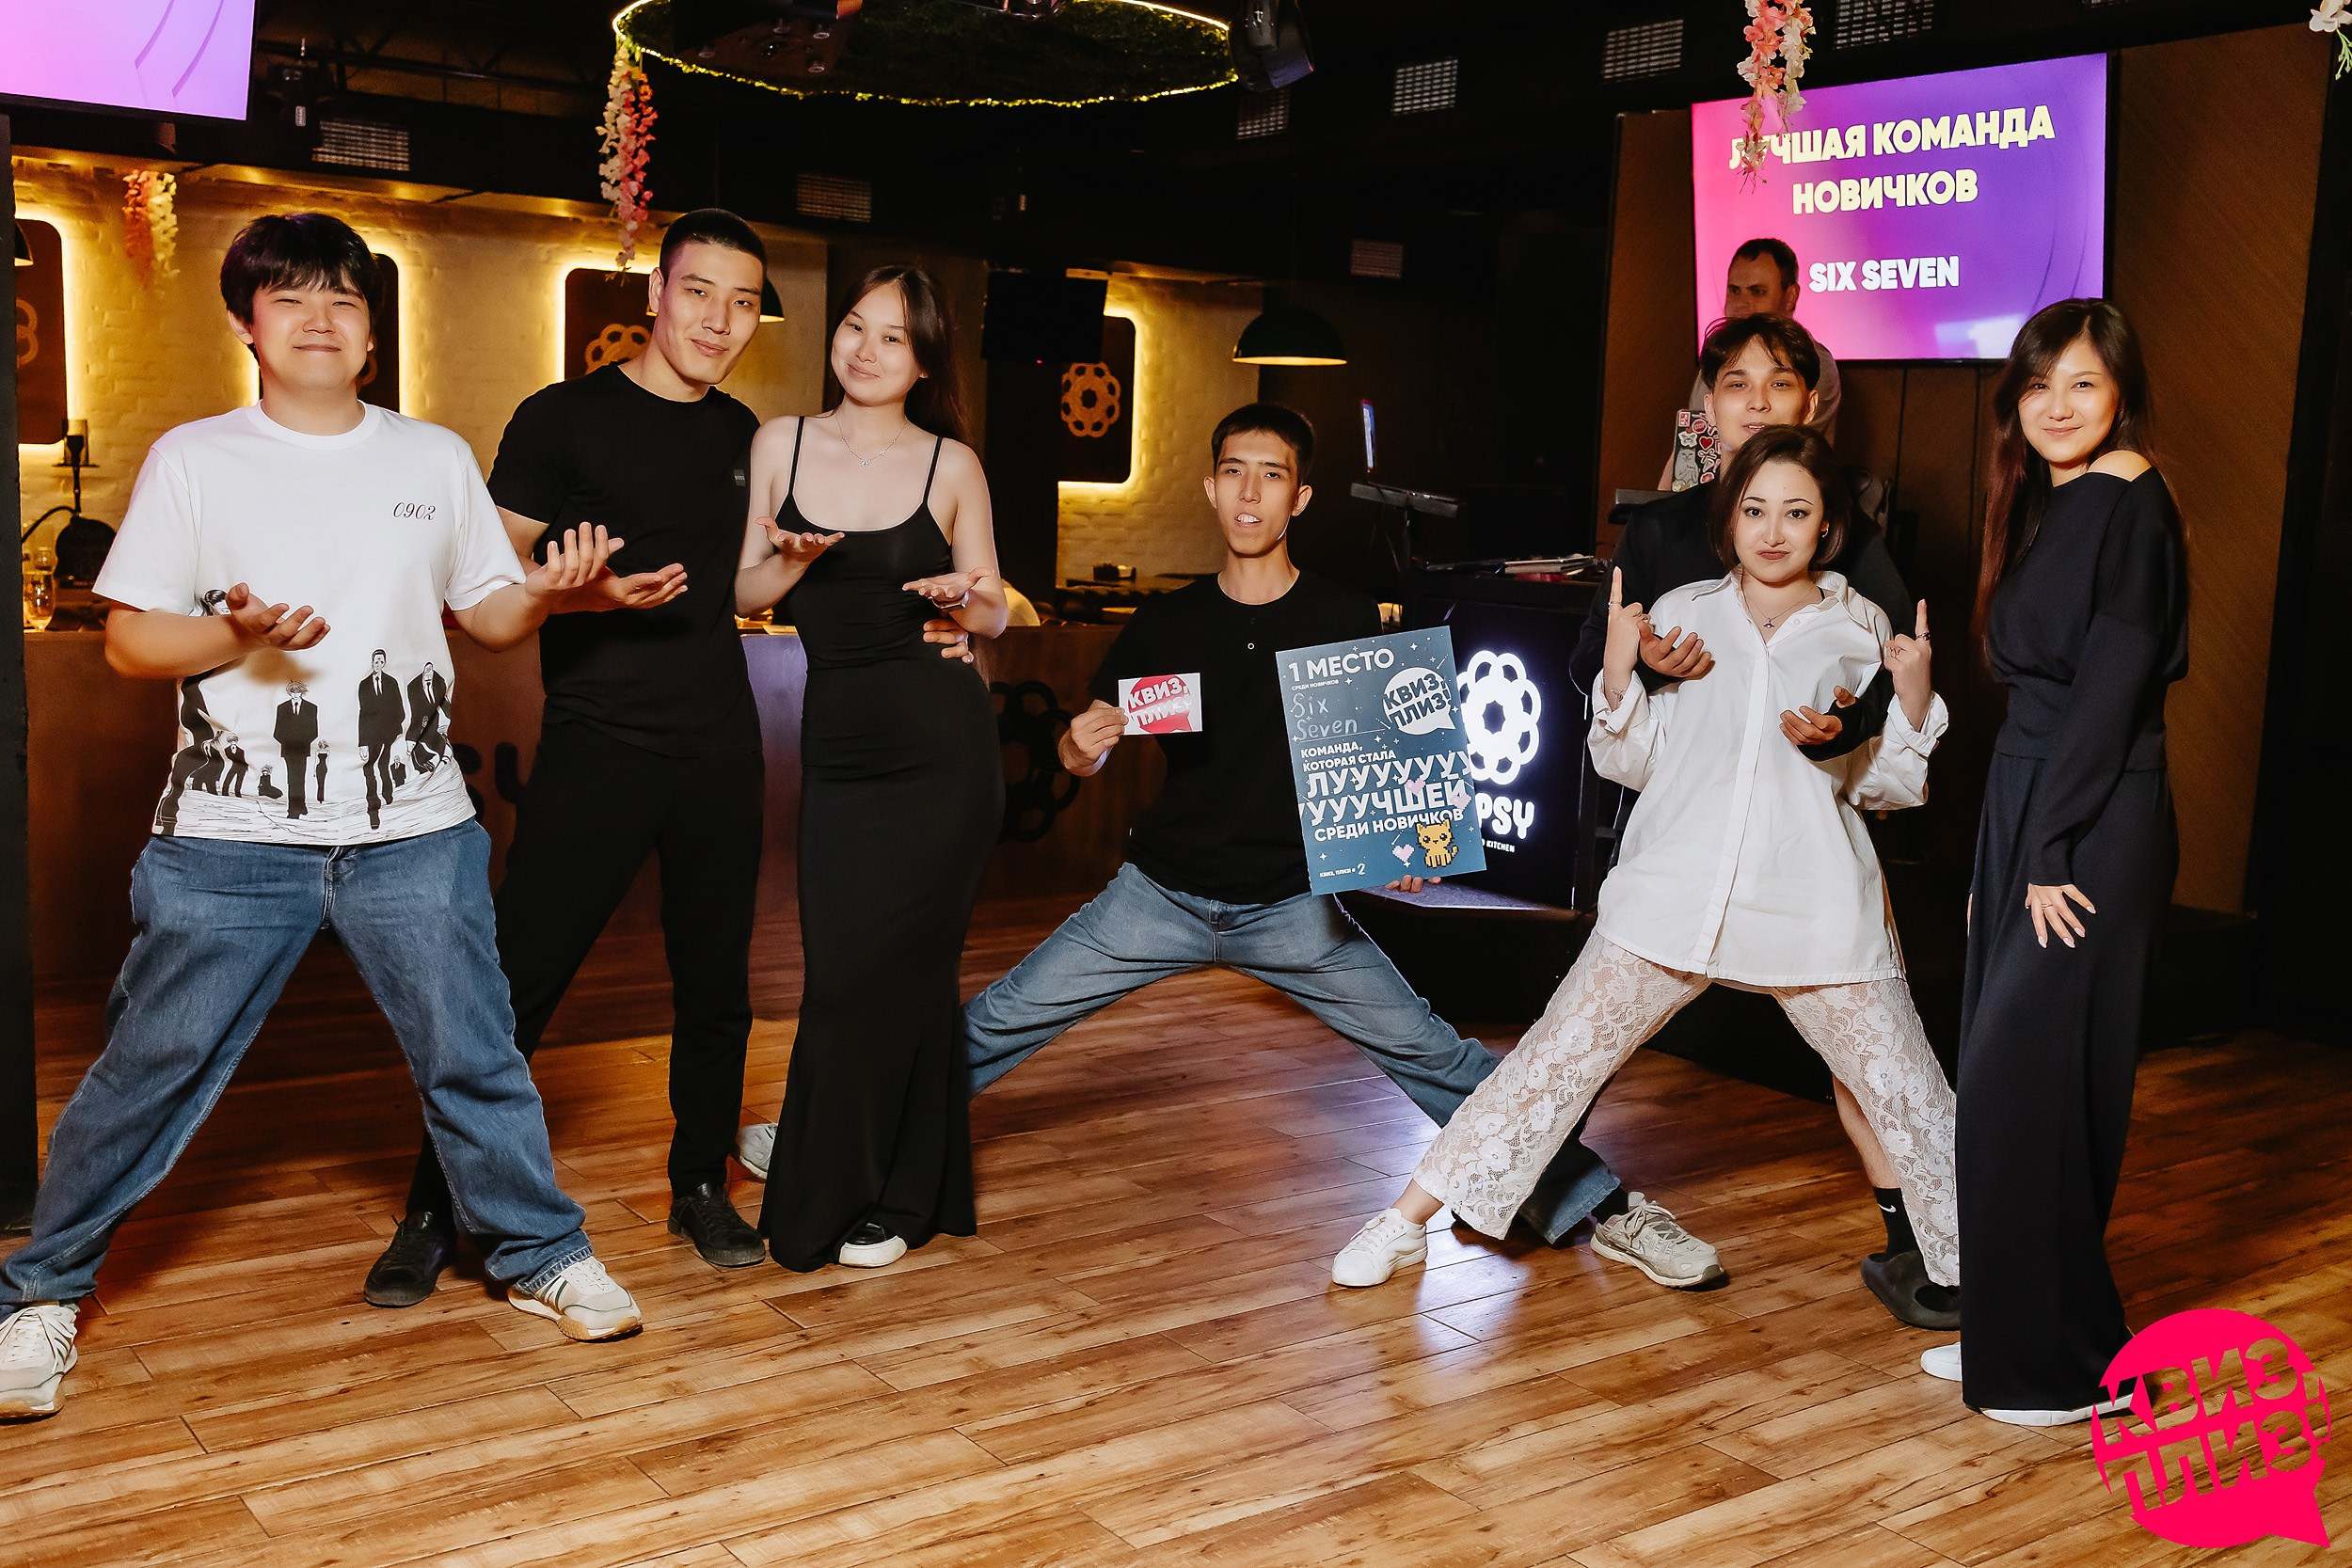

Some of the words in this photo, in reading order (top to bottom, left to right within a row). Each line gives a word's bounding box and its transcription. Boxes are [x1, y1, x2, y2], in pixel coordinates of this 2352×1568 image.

[1728, 124, 1867, 170] ЛЧШАЯ
[1873, 104, 2056, 156] КОМАНДА
[1792, 168, 1979, 214] НОВИЧКОВ
[1808, 260, 1857, 293] SIX
[1861, 255, 1960, 292] SEVEN
[393, 501, 436, 520] 0902
[1288, 662, 1300, 682] 1
[1306, 648, 1394, 680] МЕСТО
[1310, 679, 1340, 688] НОВИЧКОВ
[1293, 692, 1328, 718] Six
[1296, 719, 1358, 741] Seven
[1300, 741, 1363, 758] КОМАНДА,
[1302, 755, 1356, 771] КОТОРАЯ
[1358, 750, 1396, 764] СТАЛА
[1314, 822, 1370, 842] СРЕДИ
[1373, 809, 1464, 833] НОВИЧКОВ
[1486, 839, 1516, 853] KITCHEN
[1357, 863, 1365, 875] 2
